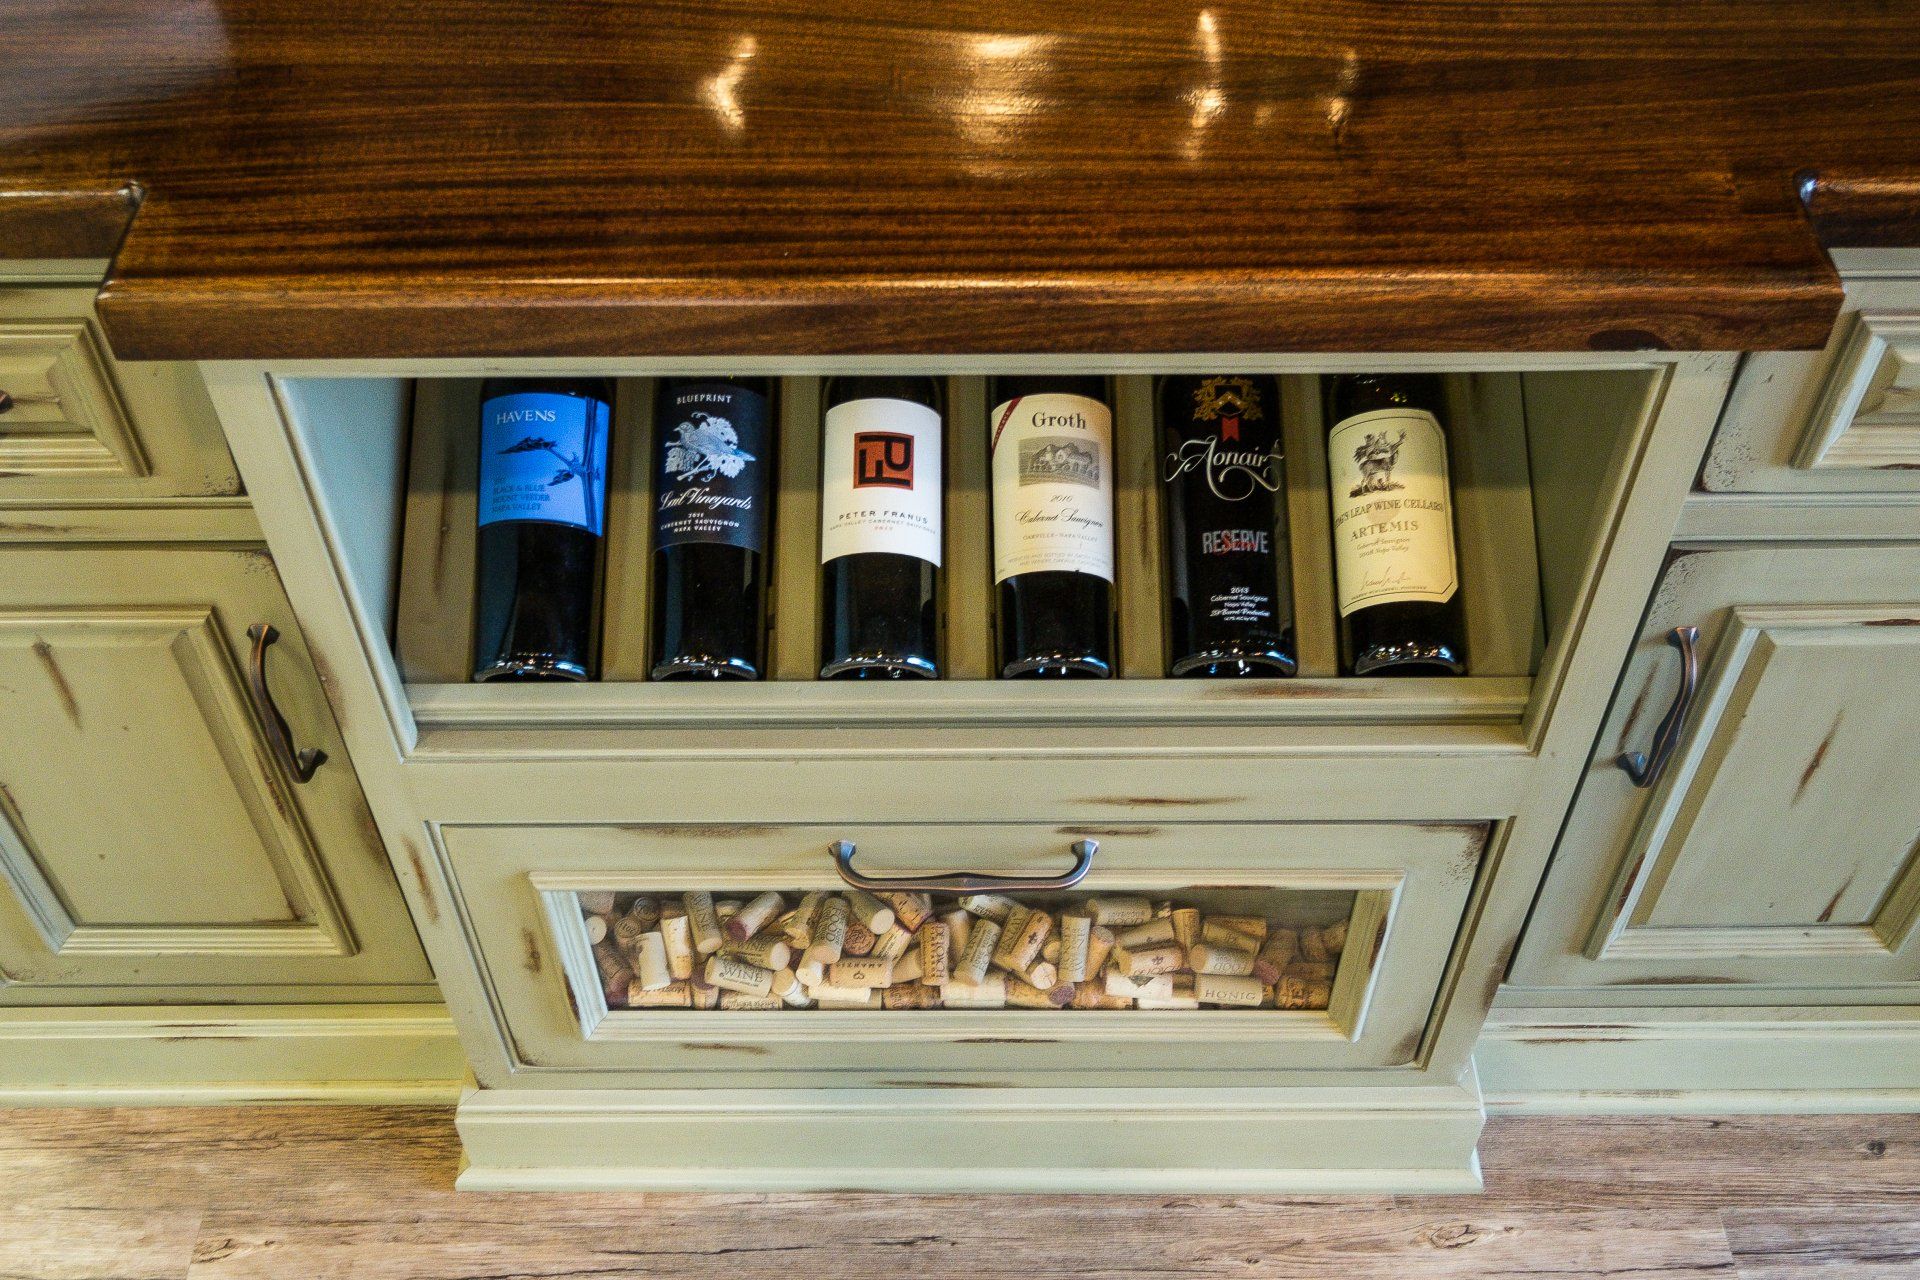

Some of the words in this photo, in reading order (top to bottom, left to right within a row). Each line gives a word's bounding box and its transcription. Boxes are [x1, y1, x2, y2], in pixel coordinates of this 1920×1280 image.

[676, 394, 732, 405] BLUEPRINT
[496, 410, 556, 425] HAVENS
[1031, 411, 1087, 430] Groth
[658, 490, 689, 512] Lail
[683, 487, 752, 510] Vineyards
[513, 503, 542, 511] VALLEY
[1350, 504, 1372, 518] LEAP
[1374, 499, 1401, 511] WINE
[1403, 499, 1445, 512] CELLARS
[660, 519, 692, 530] CABERNET
[694, 519, 739, 528] SAUVIGNON
[838, 511, 876, 521] PETER
[884, 511, 928, 524] FRANUS
[1015, 508, 1059, 526] Cabernet
[1060, 508, 1104, 529] Sauvignon
[1350, 520, 1419, 541] ARTEMIS
[1202, 529, 1269, 554] RESERVE
[1356, 538, 1380, 550] Cabernet
[1381, 537, 1410, 545] Sauvignon
[1376, 547, 1390, 556] Napa
[1391, 544, 1409, 553] Valley
[1210, 594, 1238, 602] Cabernet
[1238, 594, 1269, 603] Sauvignon
[720, 960, 765, 983] WINE
[1205, 989, 1256, 1000] HONIG
